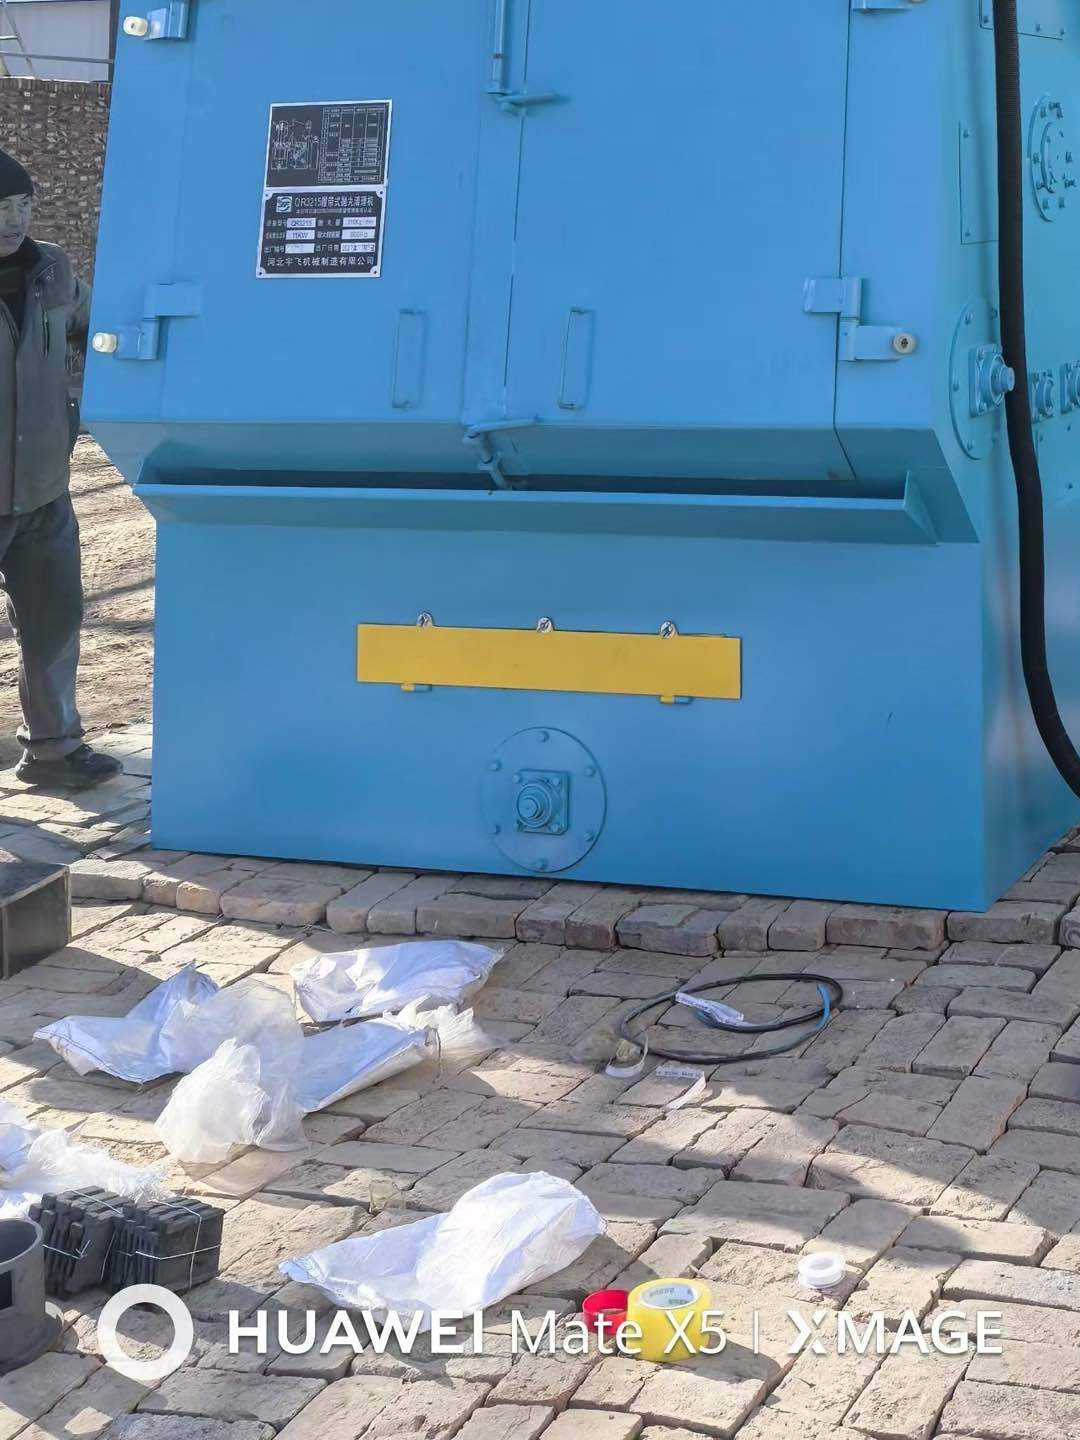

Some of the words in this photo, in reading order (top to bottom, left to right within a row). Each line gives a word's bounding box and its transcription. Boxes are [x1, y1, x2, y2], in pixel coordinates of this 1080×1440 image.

[267, 256, 375, 267] 河北宇飞机械制造有限公司
